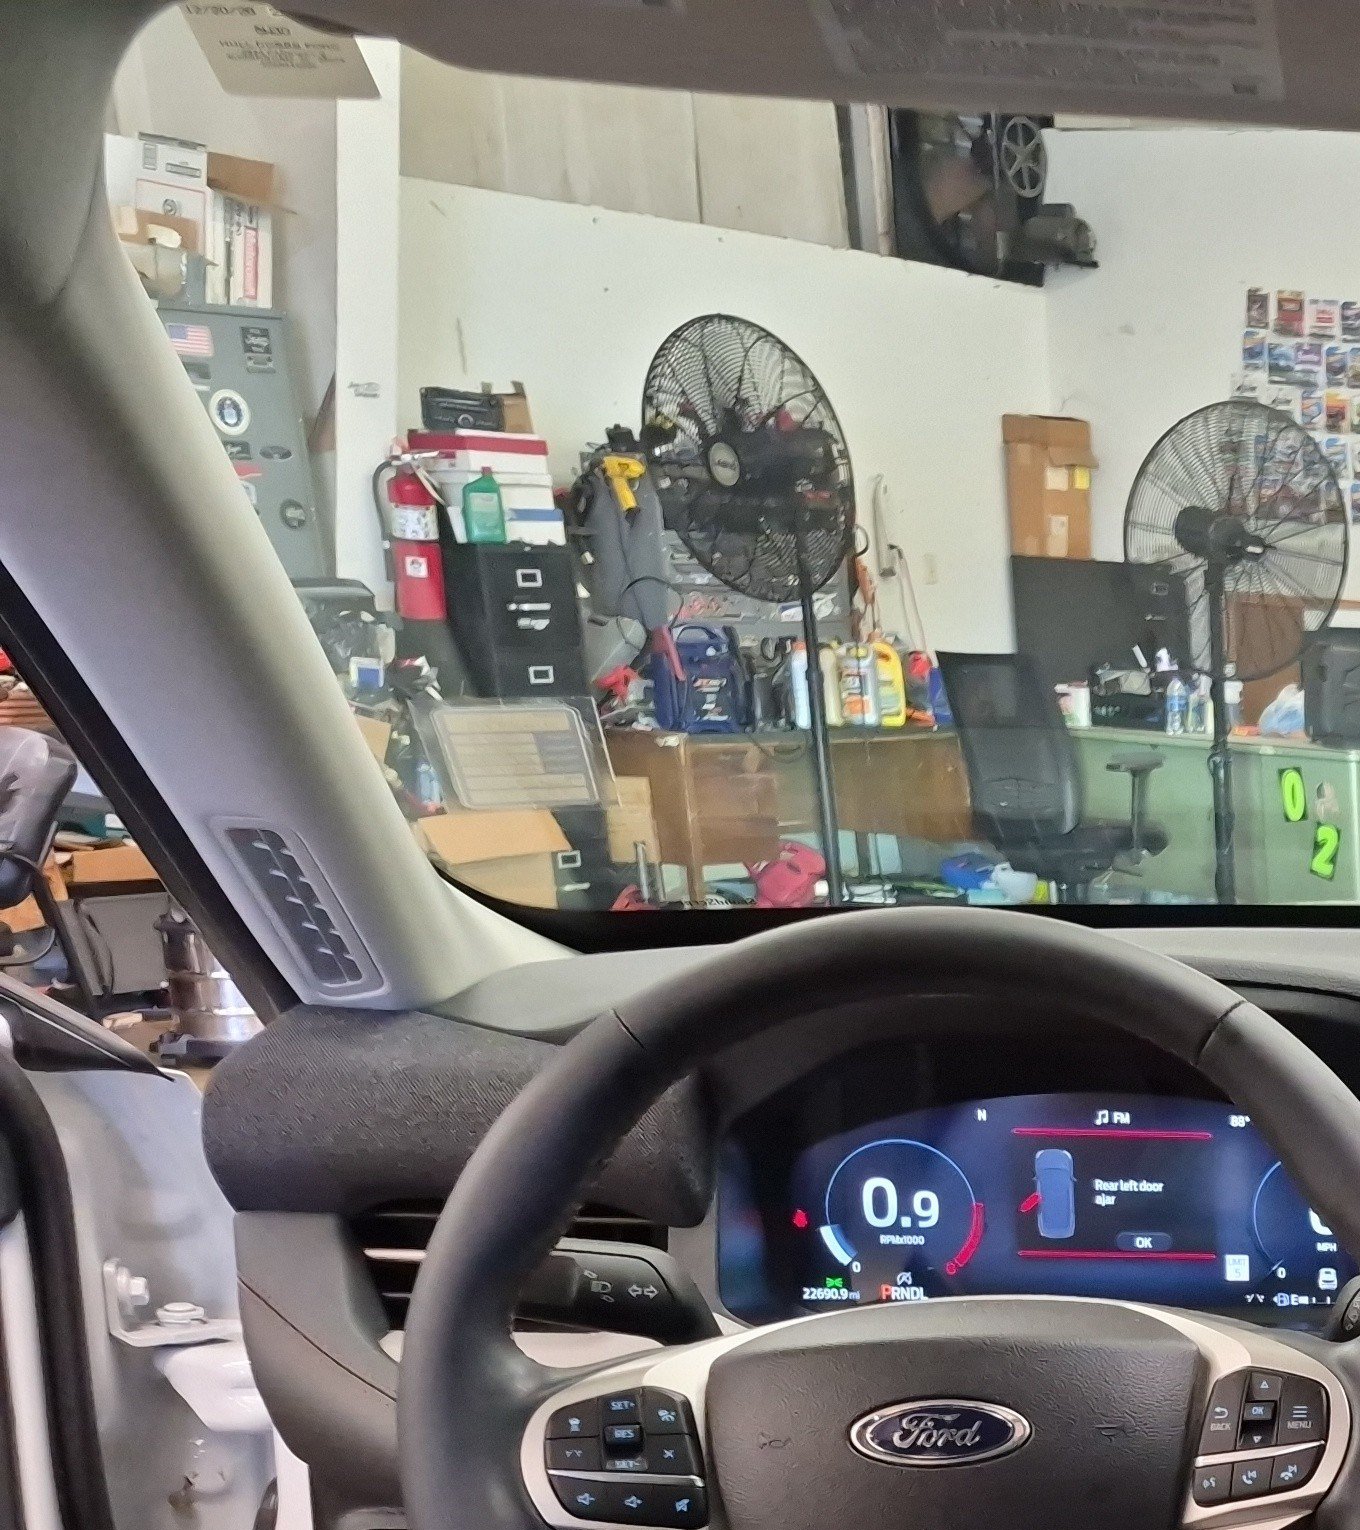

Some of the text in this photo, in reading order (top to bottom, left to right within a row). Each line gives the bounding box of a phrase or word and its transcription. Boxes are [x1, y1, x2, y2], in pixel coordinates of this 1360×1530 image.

[1310, 824, 1340, 877] 2
[977, 1109, 987, 1122] N
[1112, 1111, 1131, 1124] FM
[1094, 1179, 1164, 1192] Rear left door
[862, 1176, 940, 1229] 0.9
[1094, 1194, 1116, 1206] ajar
[879, 1235, 925, 1246] RPMx1000
[1135, 1237, 1152, 1248] OK
[1315, 1242, 1337, 1252] MPH
[852, 1261, 861, 1273] 0
[1276, 1267, 1286, 1278] 0
[803, 1287, 861, 1300] 22690.9 mi
[1291, 1294, 1299, 1305] E
[1251, 1406, 1263, 1416] OK
[891, 1412, 980, 1449] Ford
[1210, 1421, 1231, 1431] BACK
[1286, 1420, 1312, 1430] MENU
[614, 1429, 635, 1438] RES
